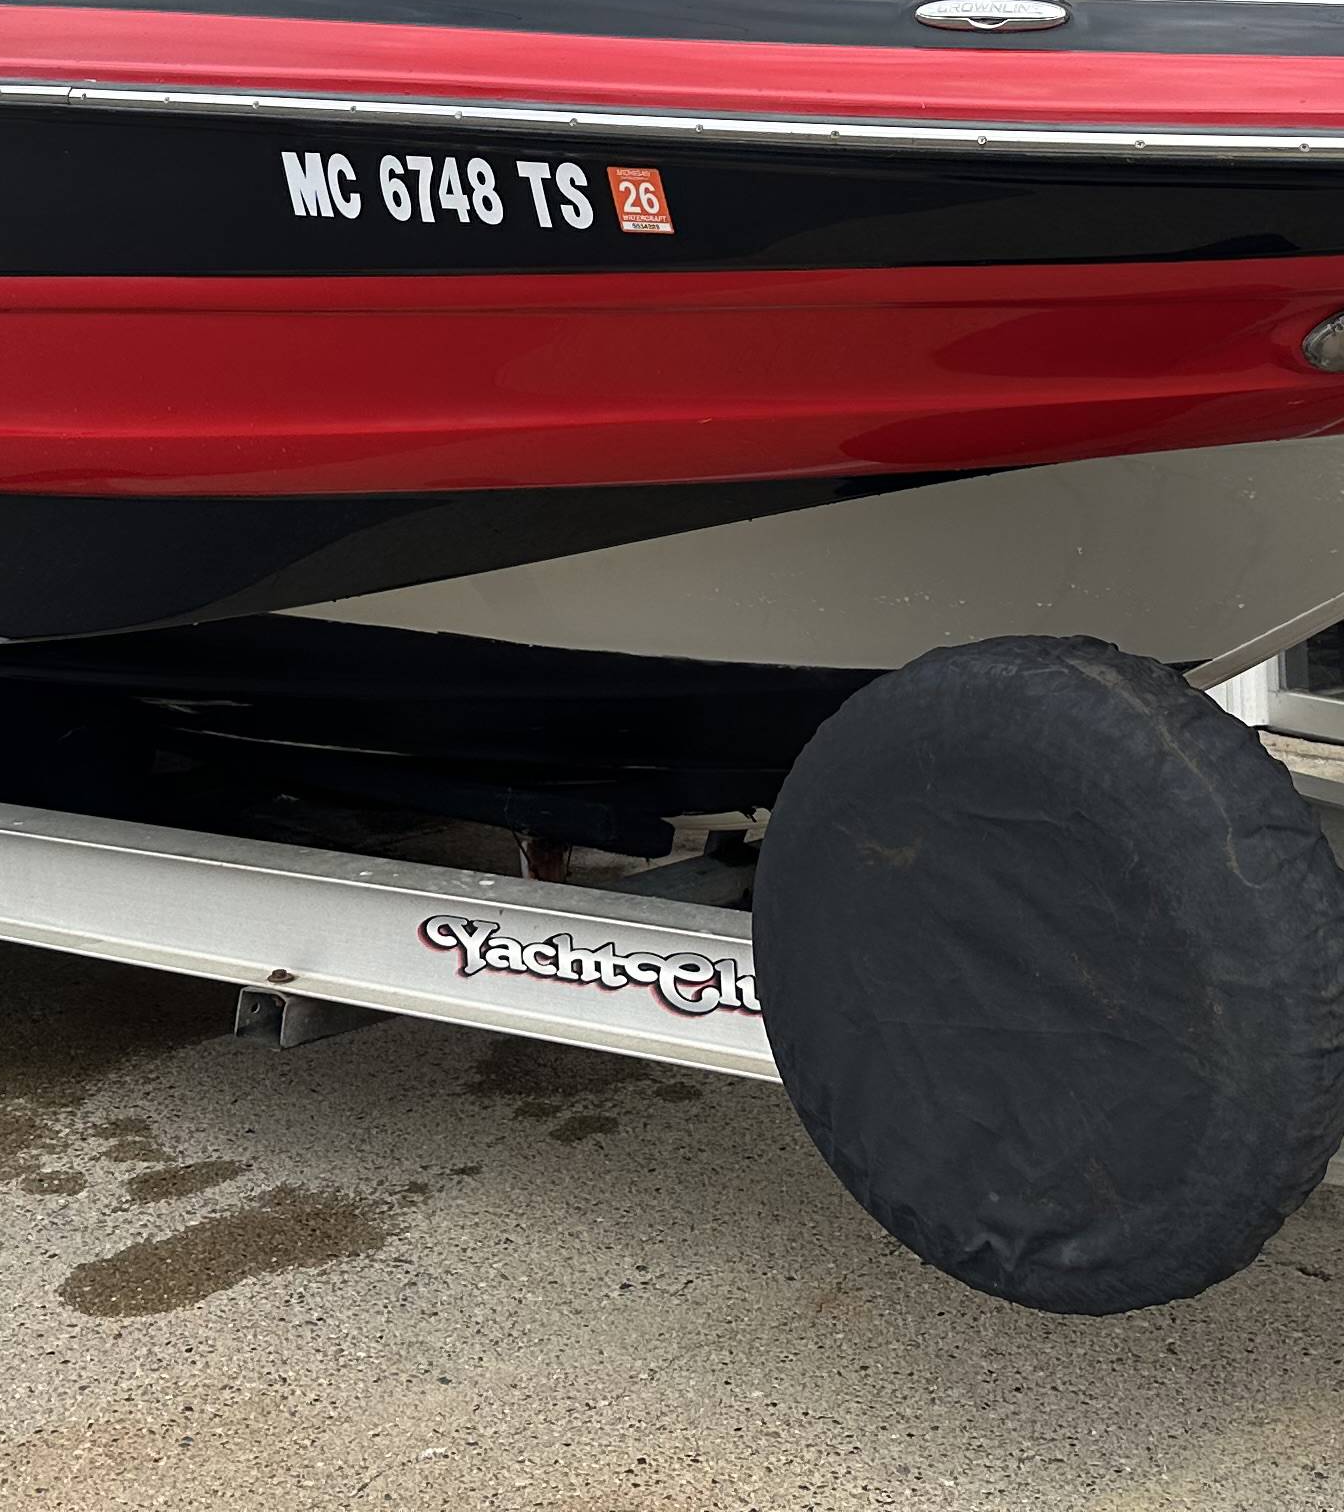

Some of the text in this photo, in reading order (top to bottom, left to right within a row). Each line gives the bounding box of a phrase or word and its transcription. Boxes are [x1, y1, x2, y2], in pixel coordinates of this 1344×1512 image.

[281, 151, 594, 230] MC 6748 TS
[619, 180, 660, 215] 26
